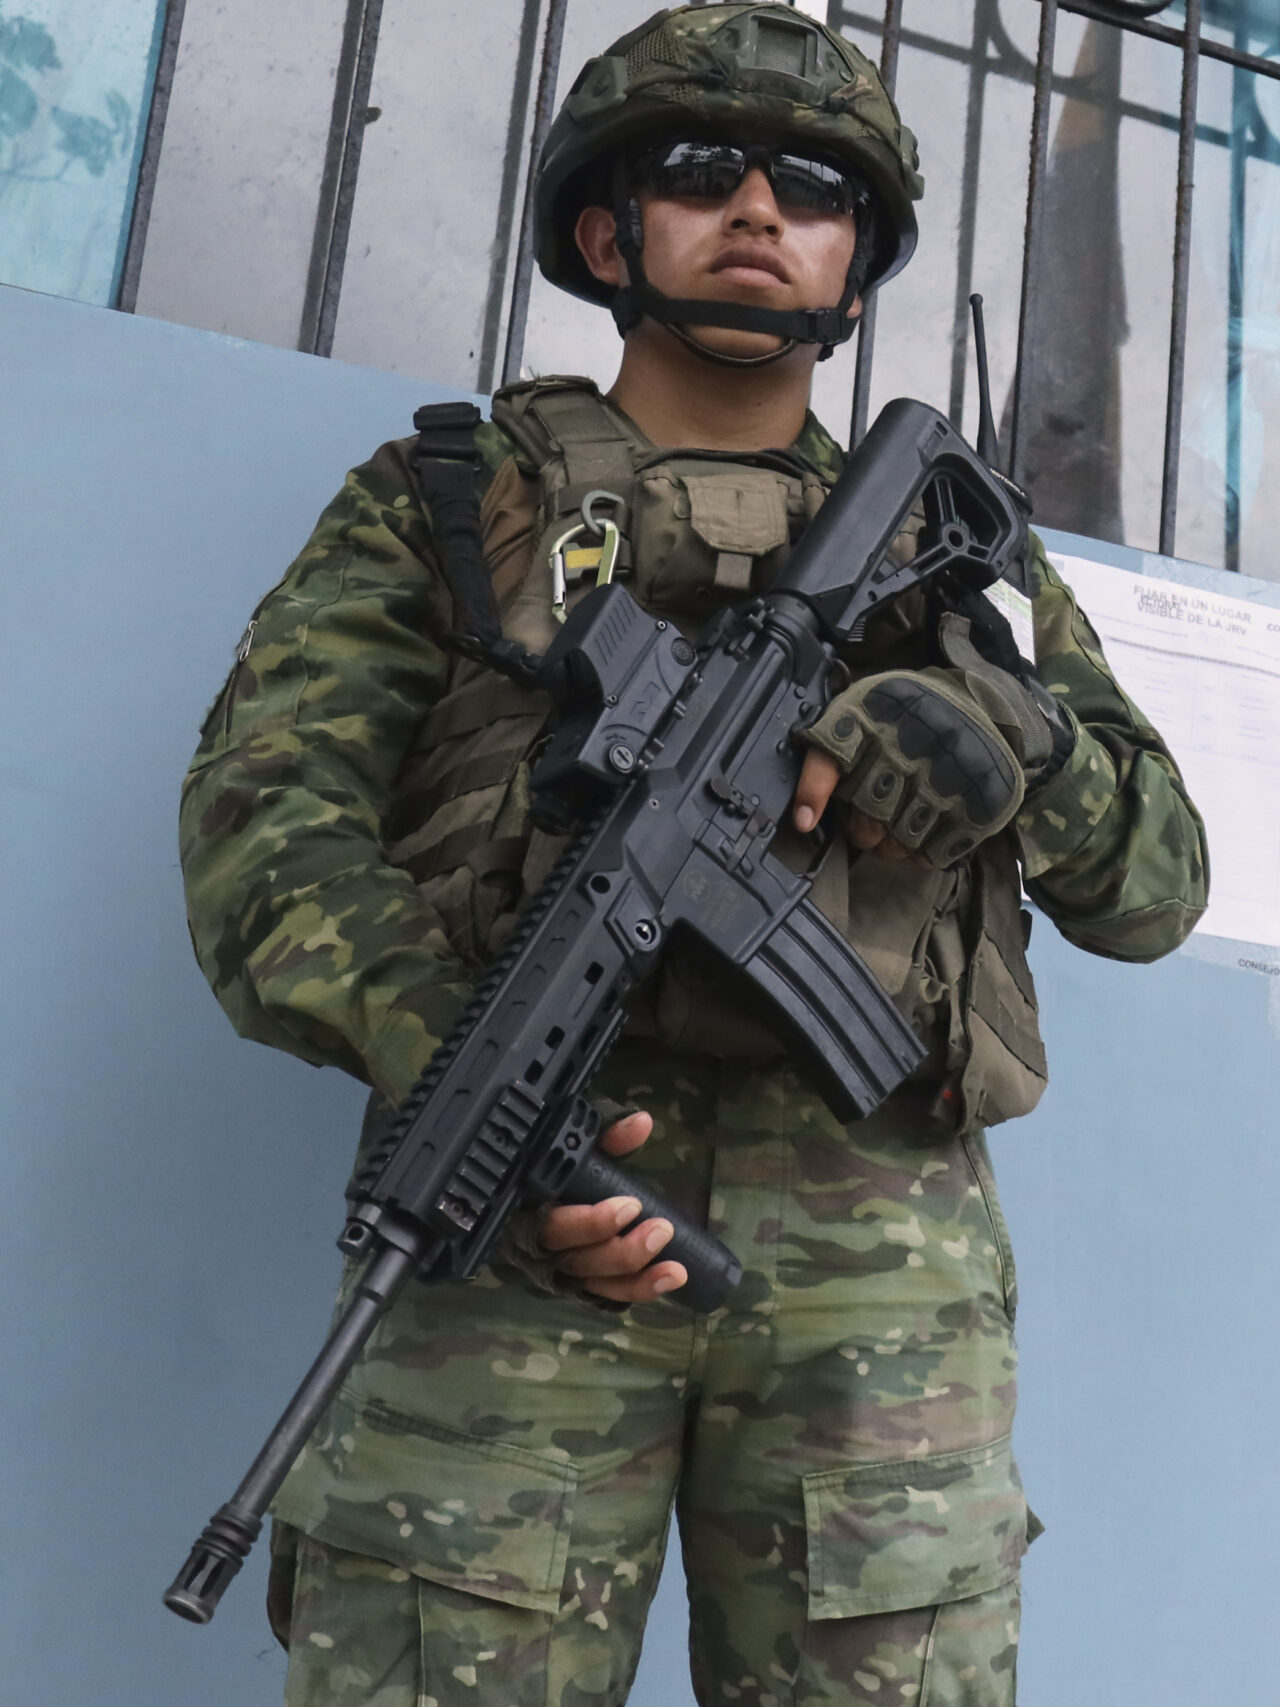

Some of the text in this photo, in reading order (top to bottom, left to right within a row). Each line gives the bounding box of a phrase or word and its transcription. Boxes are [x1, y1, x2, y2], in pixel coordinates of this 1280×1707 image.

[1137, 601, 1184, 620] VISIBLE
[1187, 612, 1204, 625] DE
[1207, 617, 1222, 628] LA
[1225, 623, 1247, 635] JRV
[1172, 594, 1187, 606] EN
[1192, 599, 1207, 610] UN
[1212, 606, 1251, 623] LUGAR
[1238, 958, 1280, 976] CONSEJO
